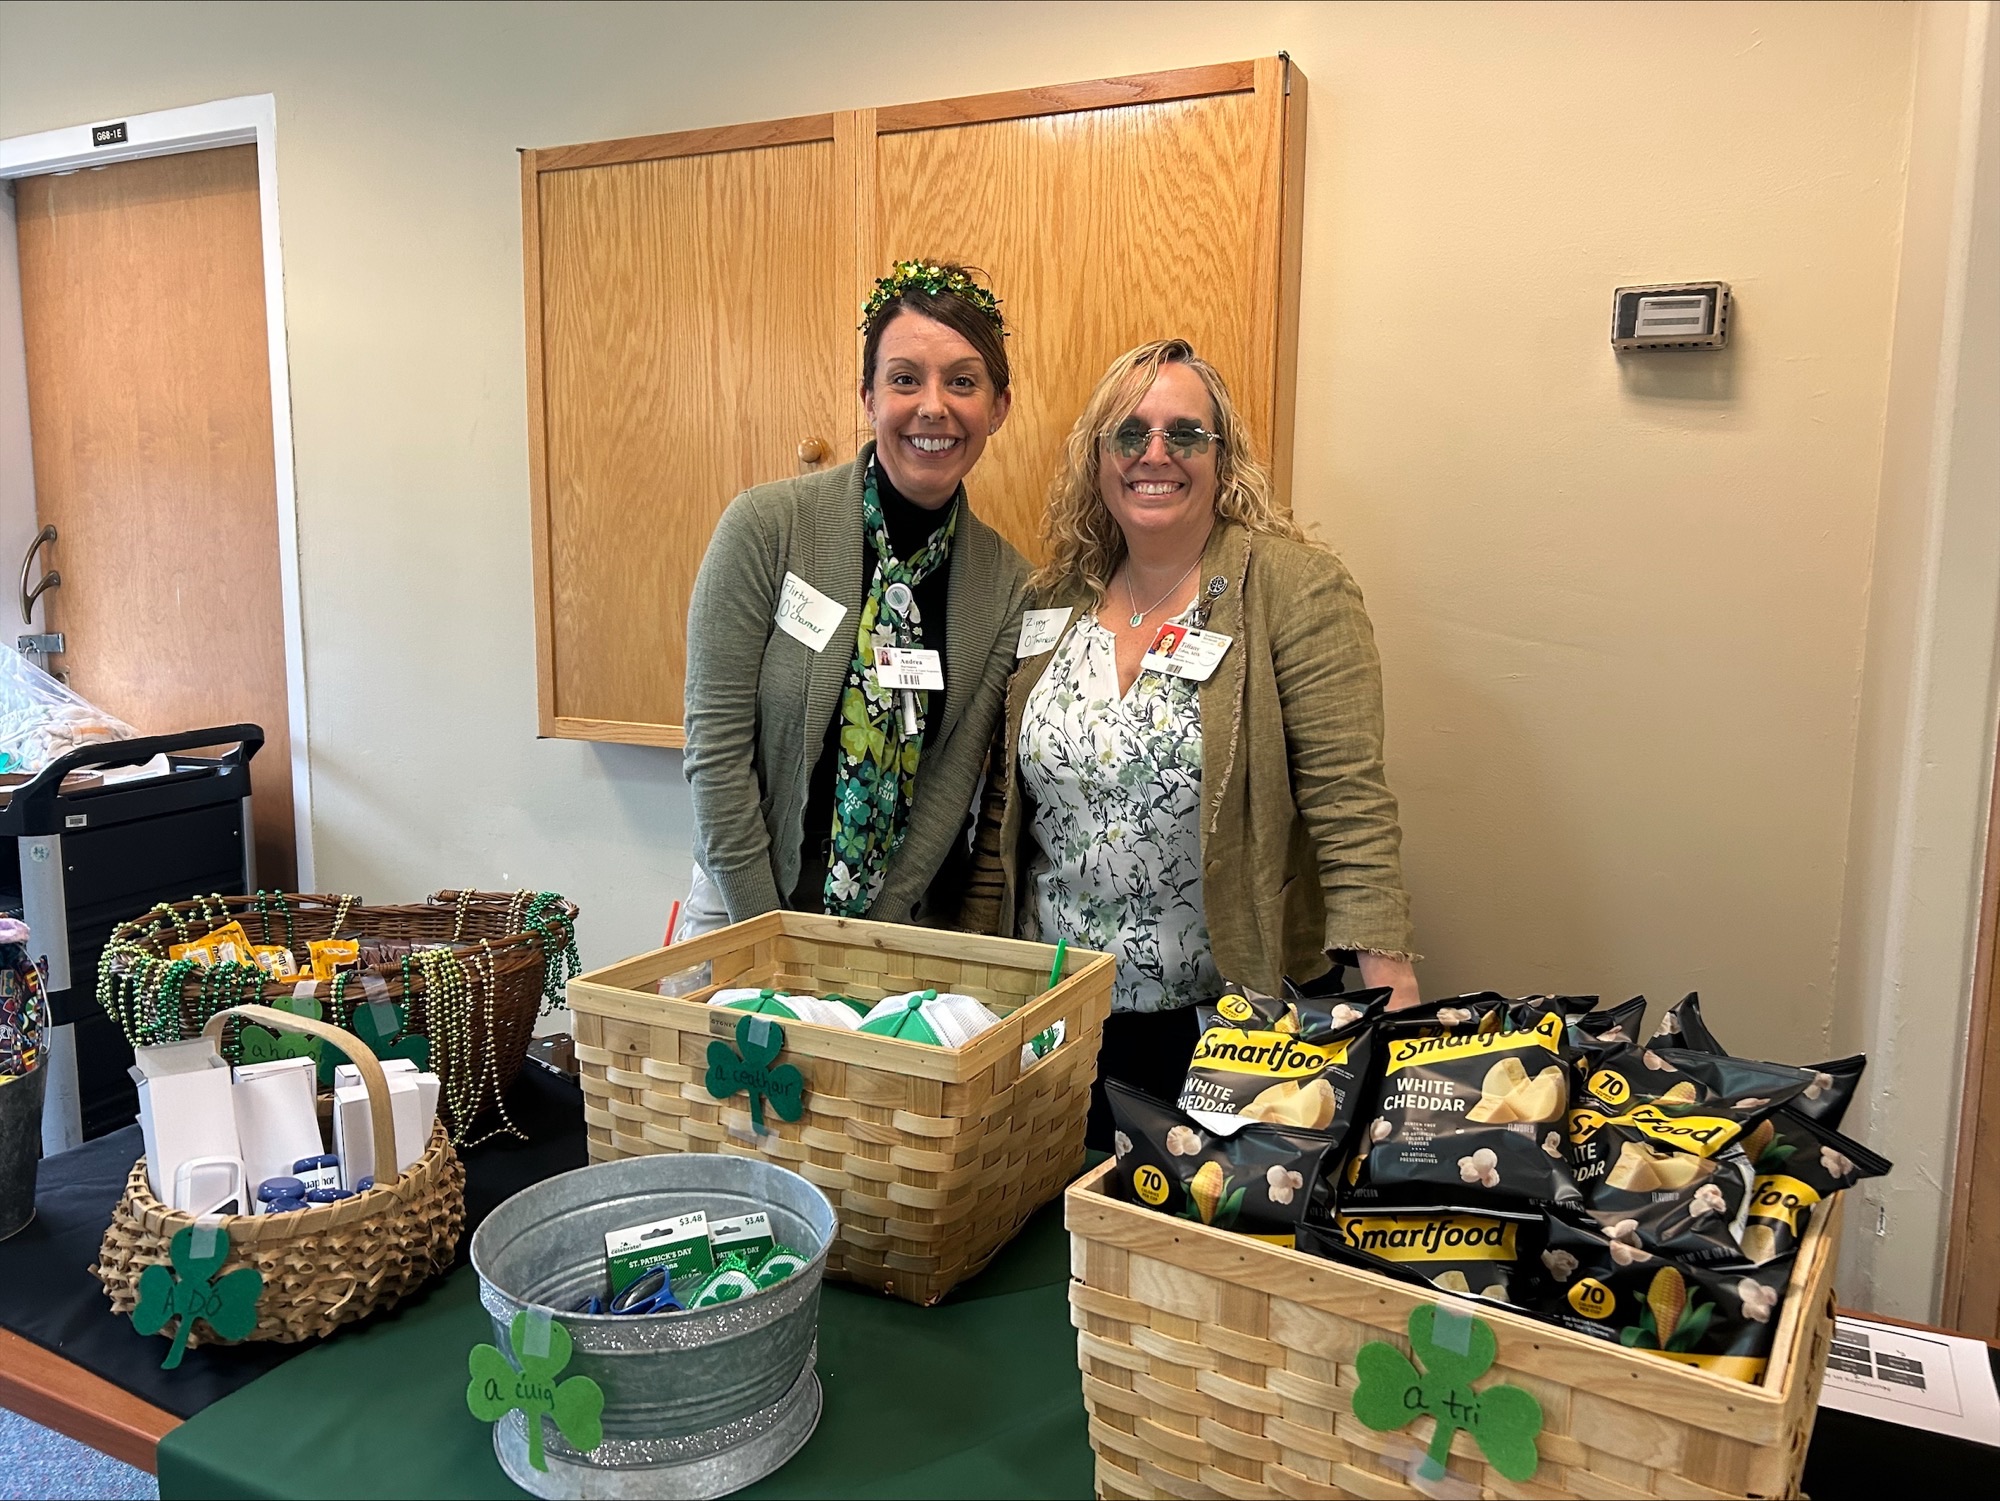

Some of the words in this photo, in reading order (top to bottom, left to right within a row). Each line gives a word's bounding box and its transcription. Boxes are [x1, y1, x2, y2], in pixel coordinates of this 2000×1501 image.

[783, 578, 813, 613] Flirty
[1226, 996, 1248, 1014] 70
[715, 1066, 726, 1080] a
[1185, 1078, 1234, 1101] WHITE
[1396, 1078, 1454, 1096] WHITE
[1598, 1072, 1624, 1096] 70
[1384, 1096, 1466, 1112] CHEDDAR
[304, 1175, 335, 1189] uaphor
[1142, 1168, 1162, 1191] 70
[679, 1214, 702, 1226] $3.48
[744, 1215, 764, 1226] $3.48
[1341, 1218, 1505, 1254] Smartfood
[628, 1260, 640, 1268] ST.
[640, 1251, 676, 1266] PATRICK'S
[677, 1248, 692, 1257] DAY
[746, 1246, 760, 1254] DAY
[162, 1286, 175, 1314] A
[1580, 1282, 1605, 1304] 70
[484, 1378, 504, 1401] a
[1404, 1386, 1430, 1409] a
